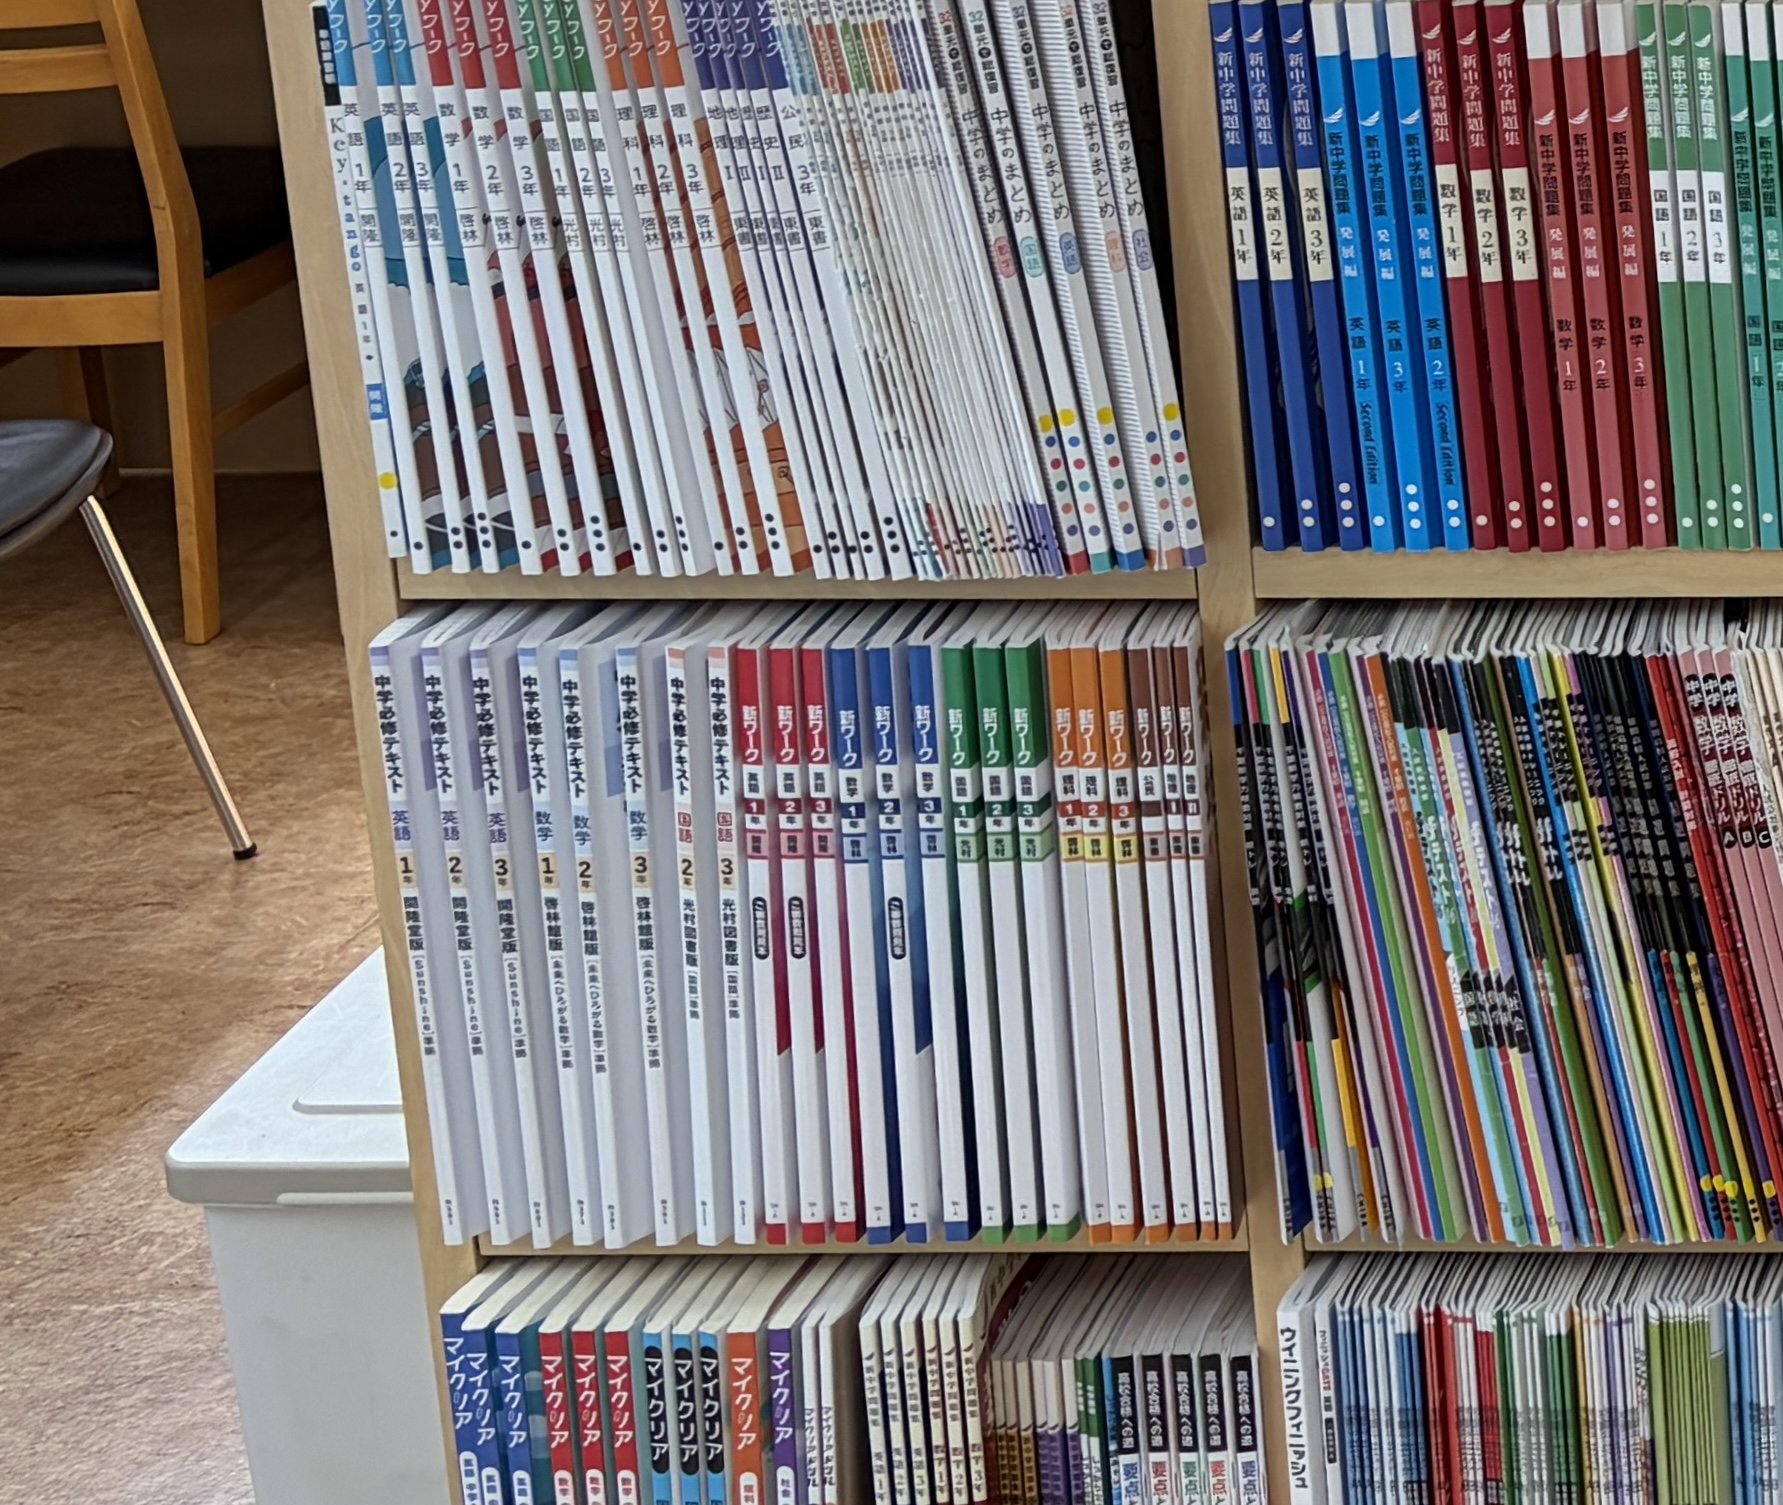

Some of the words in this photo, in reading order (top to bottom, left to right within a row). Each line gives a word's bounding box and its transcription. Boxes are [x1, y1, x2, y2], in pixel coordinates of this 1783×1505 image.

[1217, 51, 1241, 146] 新中学問題集
[990, 108, 1032, 223] 中学のまとめ
[1032, 102, 1070, 220] 中学のまとめ
[374, 674, 404, 795] 中学必修テキスト
[807, 704, 827, 763] 新ワーク
[535, 811, 554, 842] 数学
[716, 811, 733, 843] 国語
[444, 1338, 472, 1429] マイクリア
[574, 1354, 600, 1447] マイクリア
[1278, 1328, 1309, 1489] ウイニングフィニッシュ
